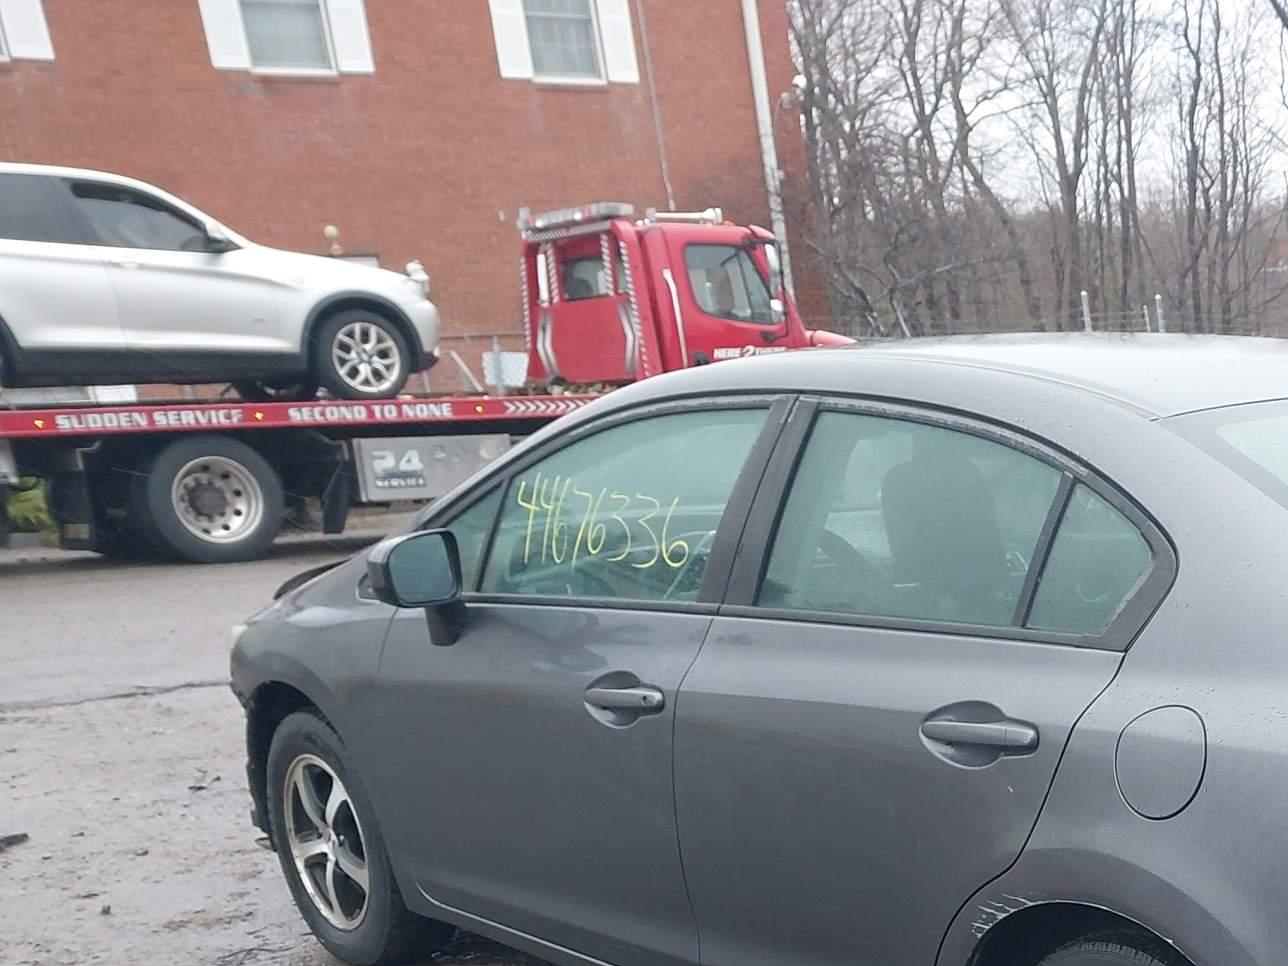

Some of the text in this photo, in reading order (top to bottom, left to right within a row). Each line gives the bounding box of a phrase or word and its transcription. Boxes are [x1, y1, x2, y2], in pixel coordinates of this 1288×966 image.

[742, 344, 755, 357] 2
[54, 402, 453, 429] SUDDEN SERVICE SECOND TO NONE
[371, 449, 425, 476] 24
[375, 477, 426, 488] SERVICE
[517, 471, 689, 574] 44676336
